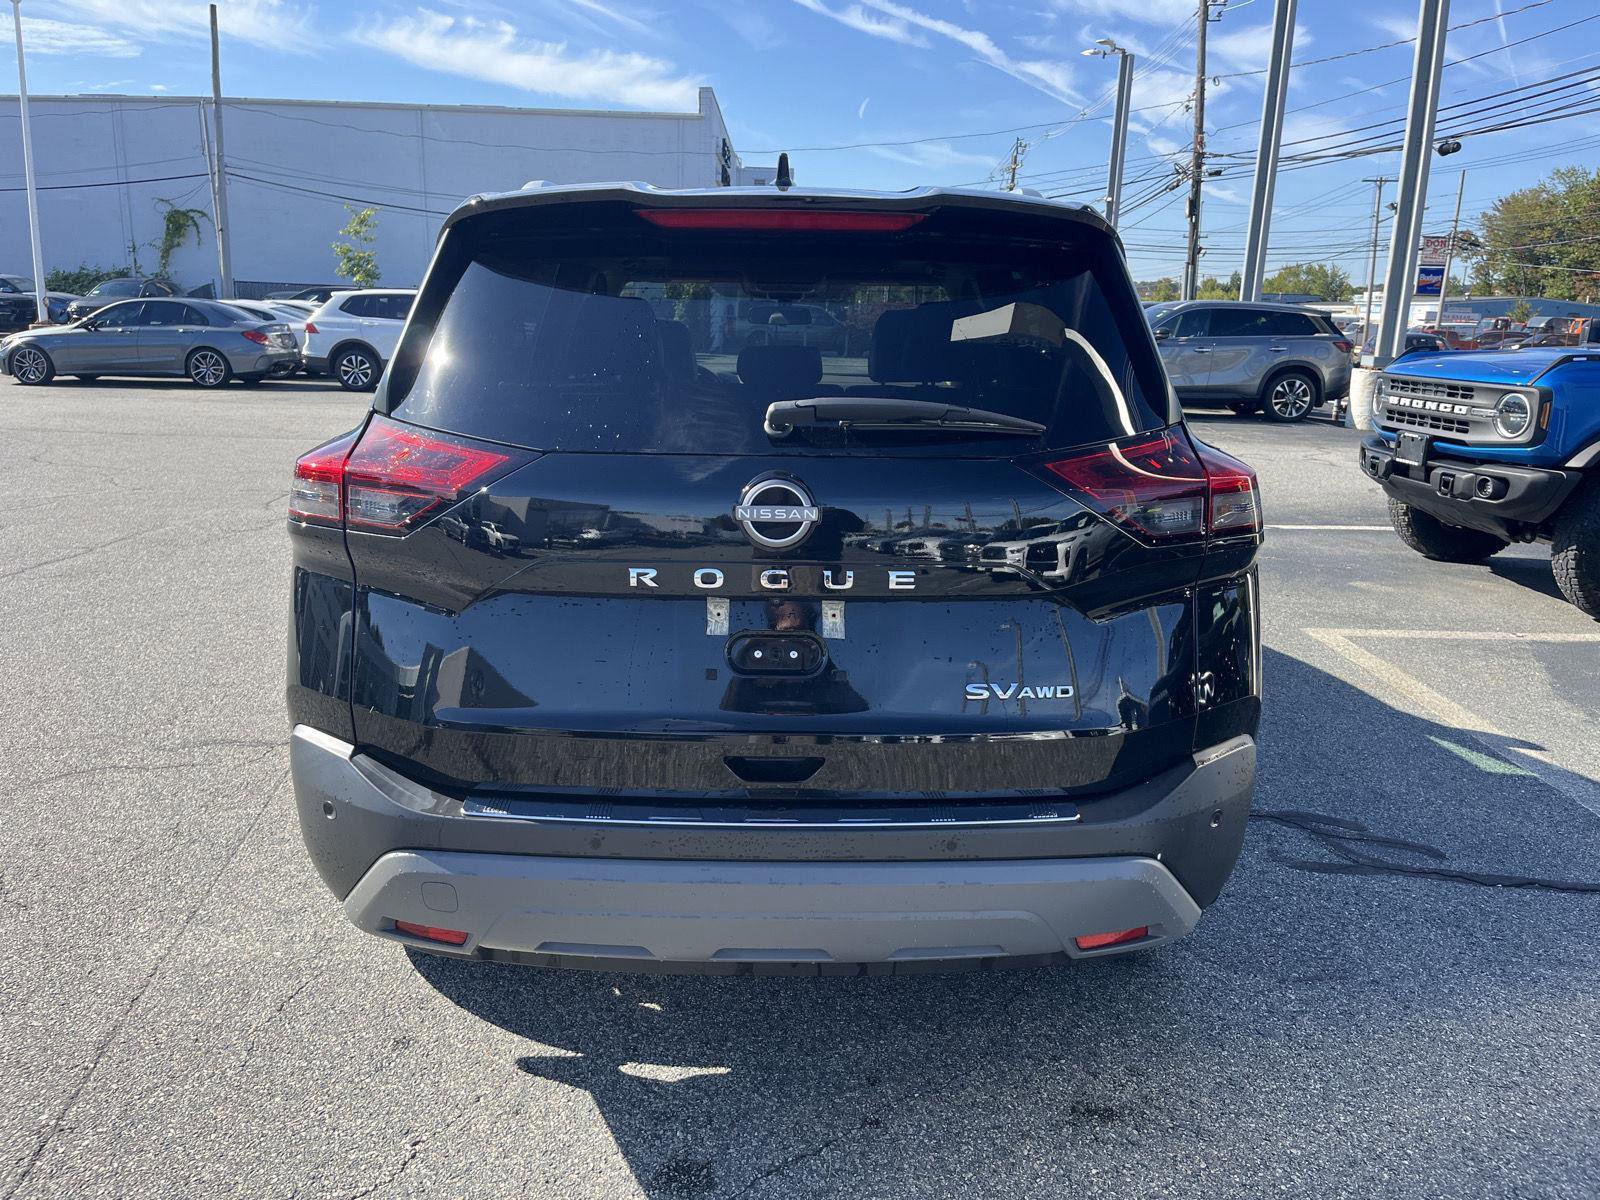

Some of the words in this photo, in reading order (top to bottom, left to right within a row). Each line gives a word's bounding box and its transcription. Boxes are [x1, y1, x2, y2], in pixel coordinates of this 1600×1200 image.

[1388, 395, 1469, 415] BRONCO
[738, 509, 816, 519] NISSAN
[628, 567, 917, 590] ROGUE
